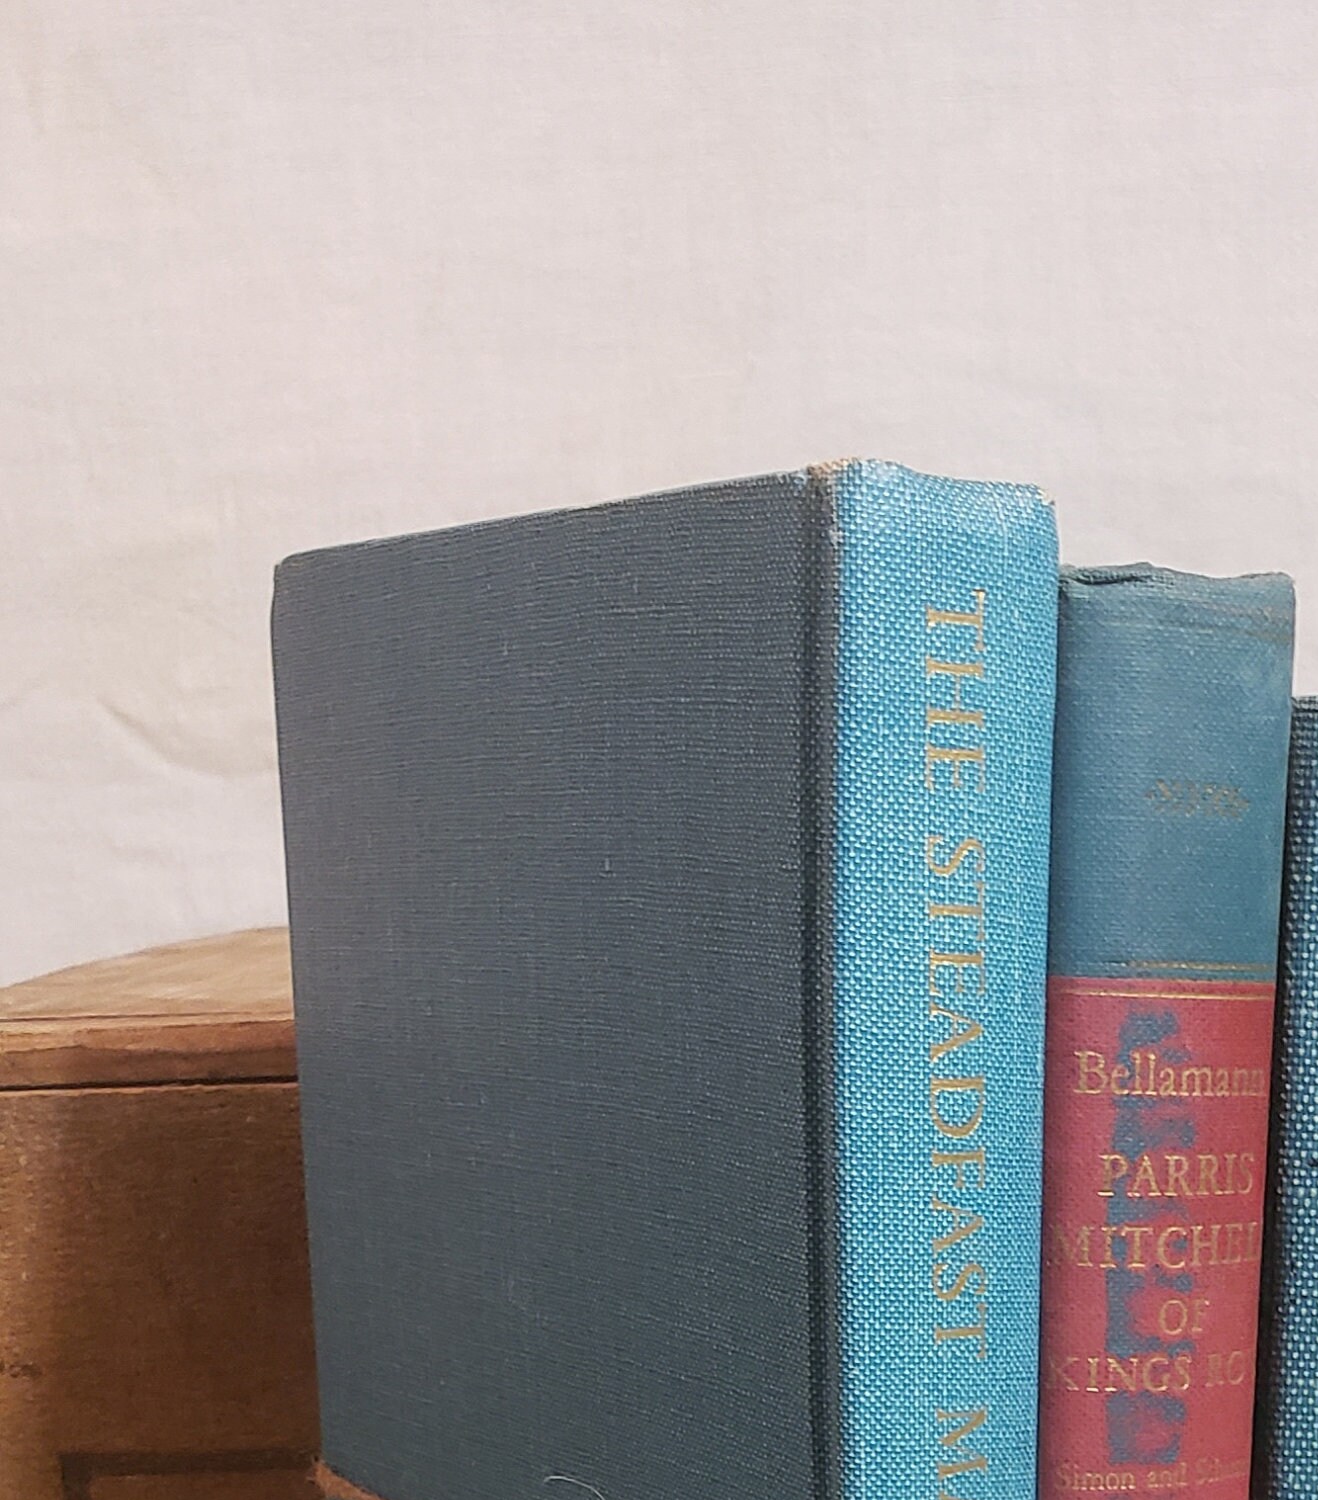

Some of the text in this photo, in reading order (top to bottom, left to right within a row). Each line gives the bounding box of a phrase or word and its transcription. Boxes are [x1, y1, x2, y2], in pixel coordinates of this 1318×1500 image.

[925, 589, 987, 795] THE
[1073, 1050, 1266, 1097] Bellamann
[927, 834, 988, 1359] STEADFAST
[1097, 1152, 1254, 1197] PARRIS
[1159, 1298, 1211, 1338] OF
[1048, 1355, 1193, 1393] KINGS
[1054, 1462, 1137, 1491] Simon
[1146, 1461, 1189, 1488] and
